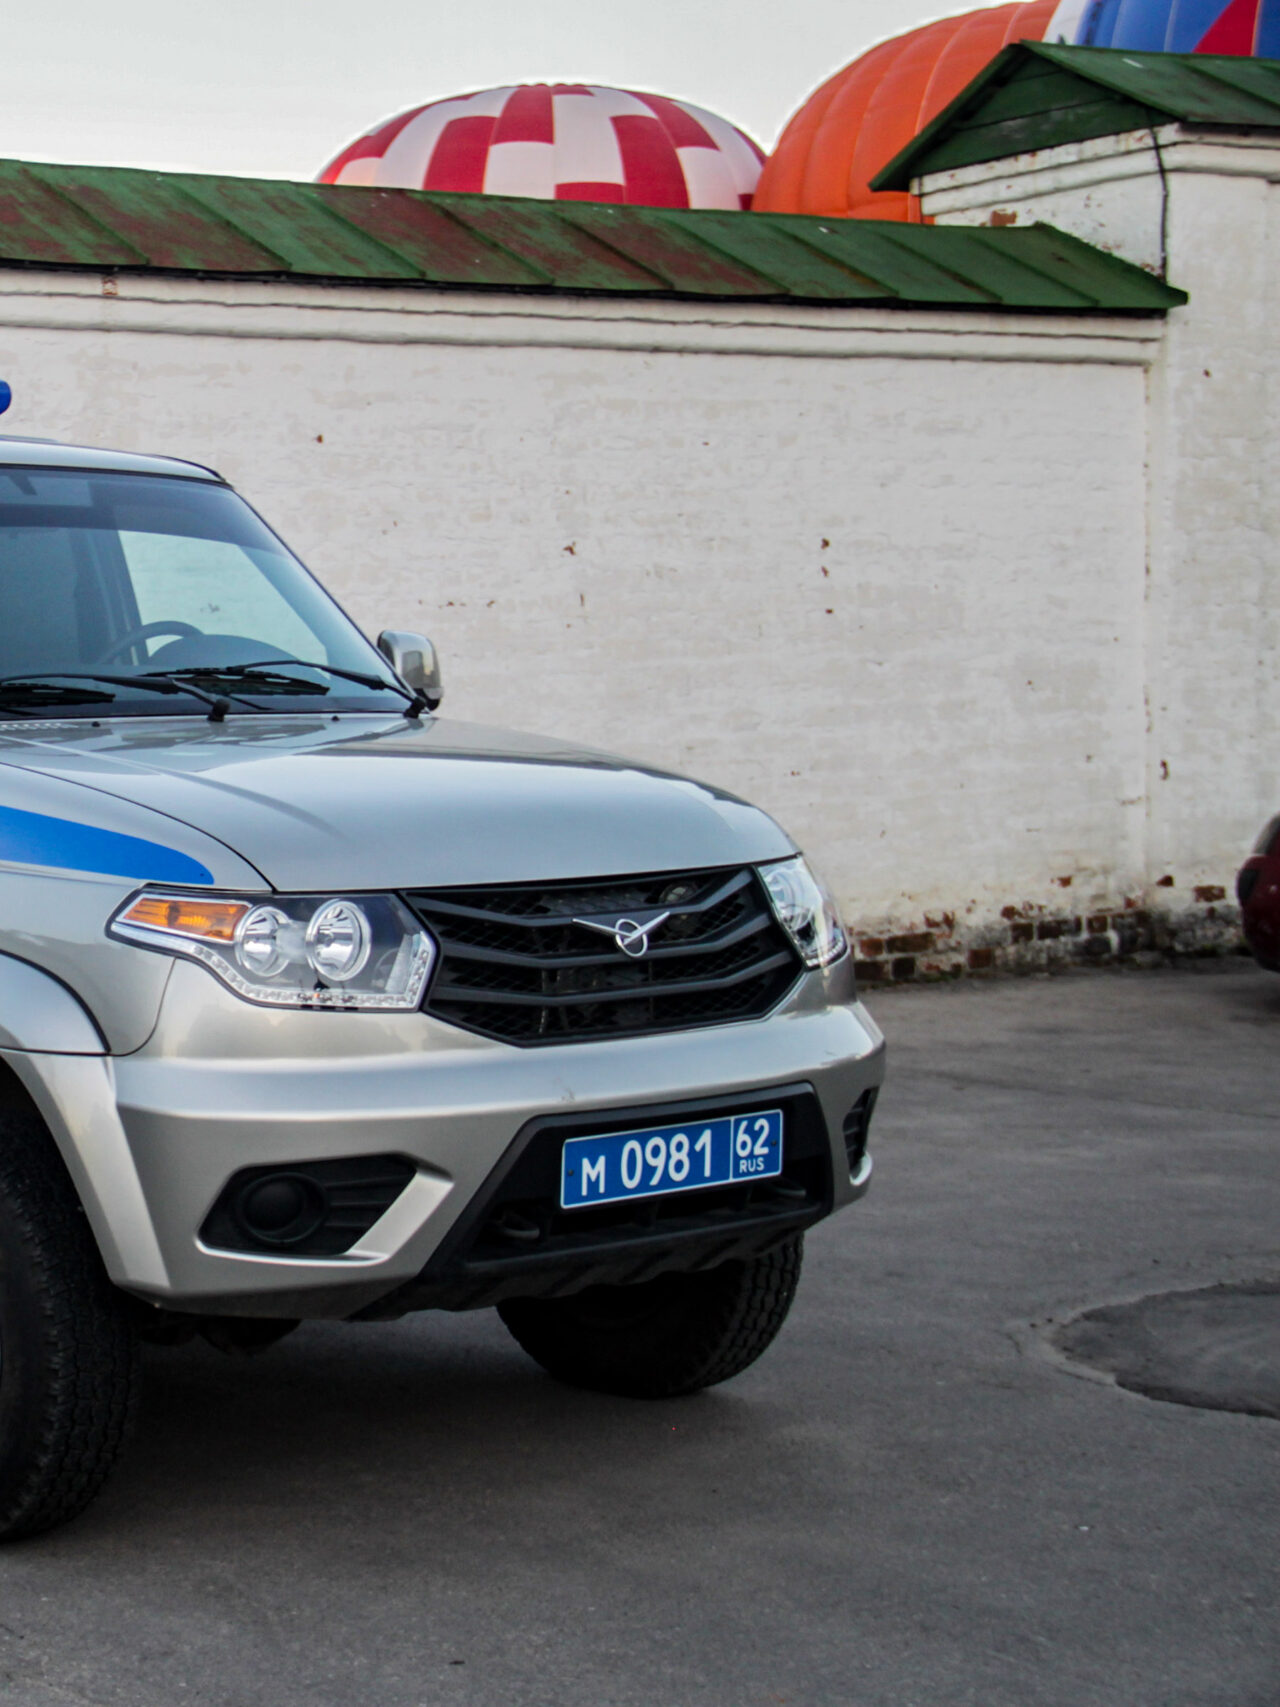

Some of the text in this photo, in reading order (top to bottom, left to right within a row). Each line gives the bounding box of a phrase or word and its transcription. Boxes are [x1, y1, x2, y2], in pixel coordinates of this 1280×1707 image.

[735, 1118, 770, 1157] 62
[620, 1129, 712, 1189] 0981
[739, 1158, 765, 1174] RUS
